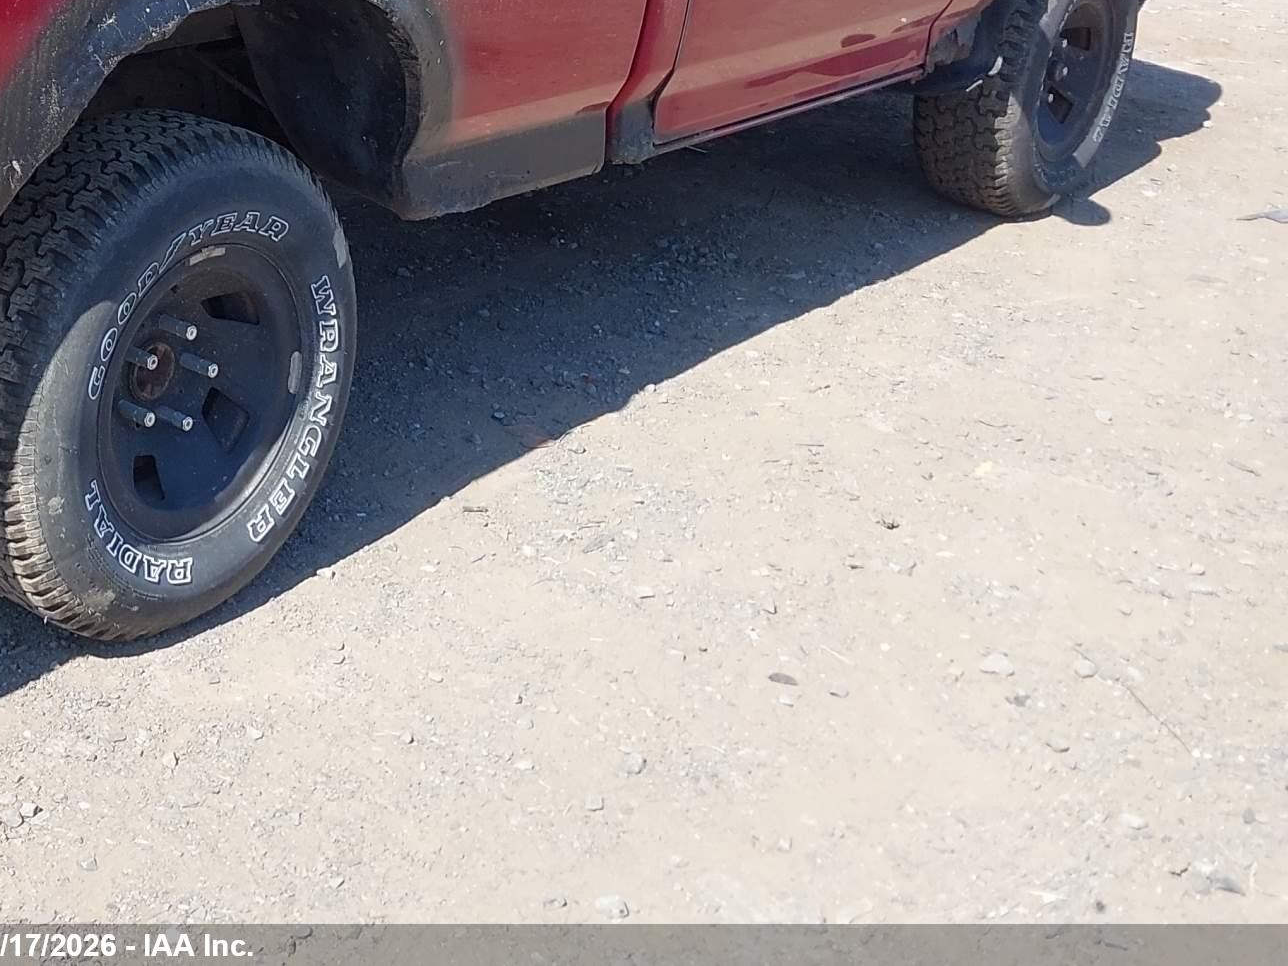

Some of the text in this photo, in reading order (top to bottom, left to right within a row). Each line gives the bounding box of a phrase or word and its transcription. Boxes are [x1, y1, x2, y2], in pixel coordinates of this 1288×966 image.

[89, 211, 289, 400] GOODYEAR
[248, 276, 339, 542] WRANGLER
[85, 479, 193, 585] RADIAL
